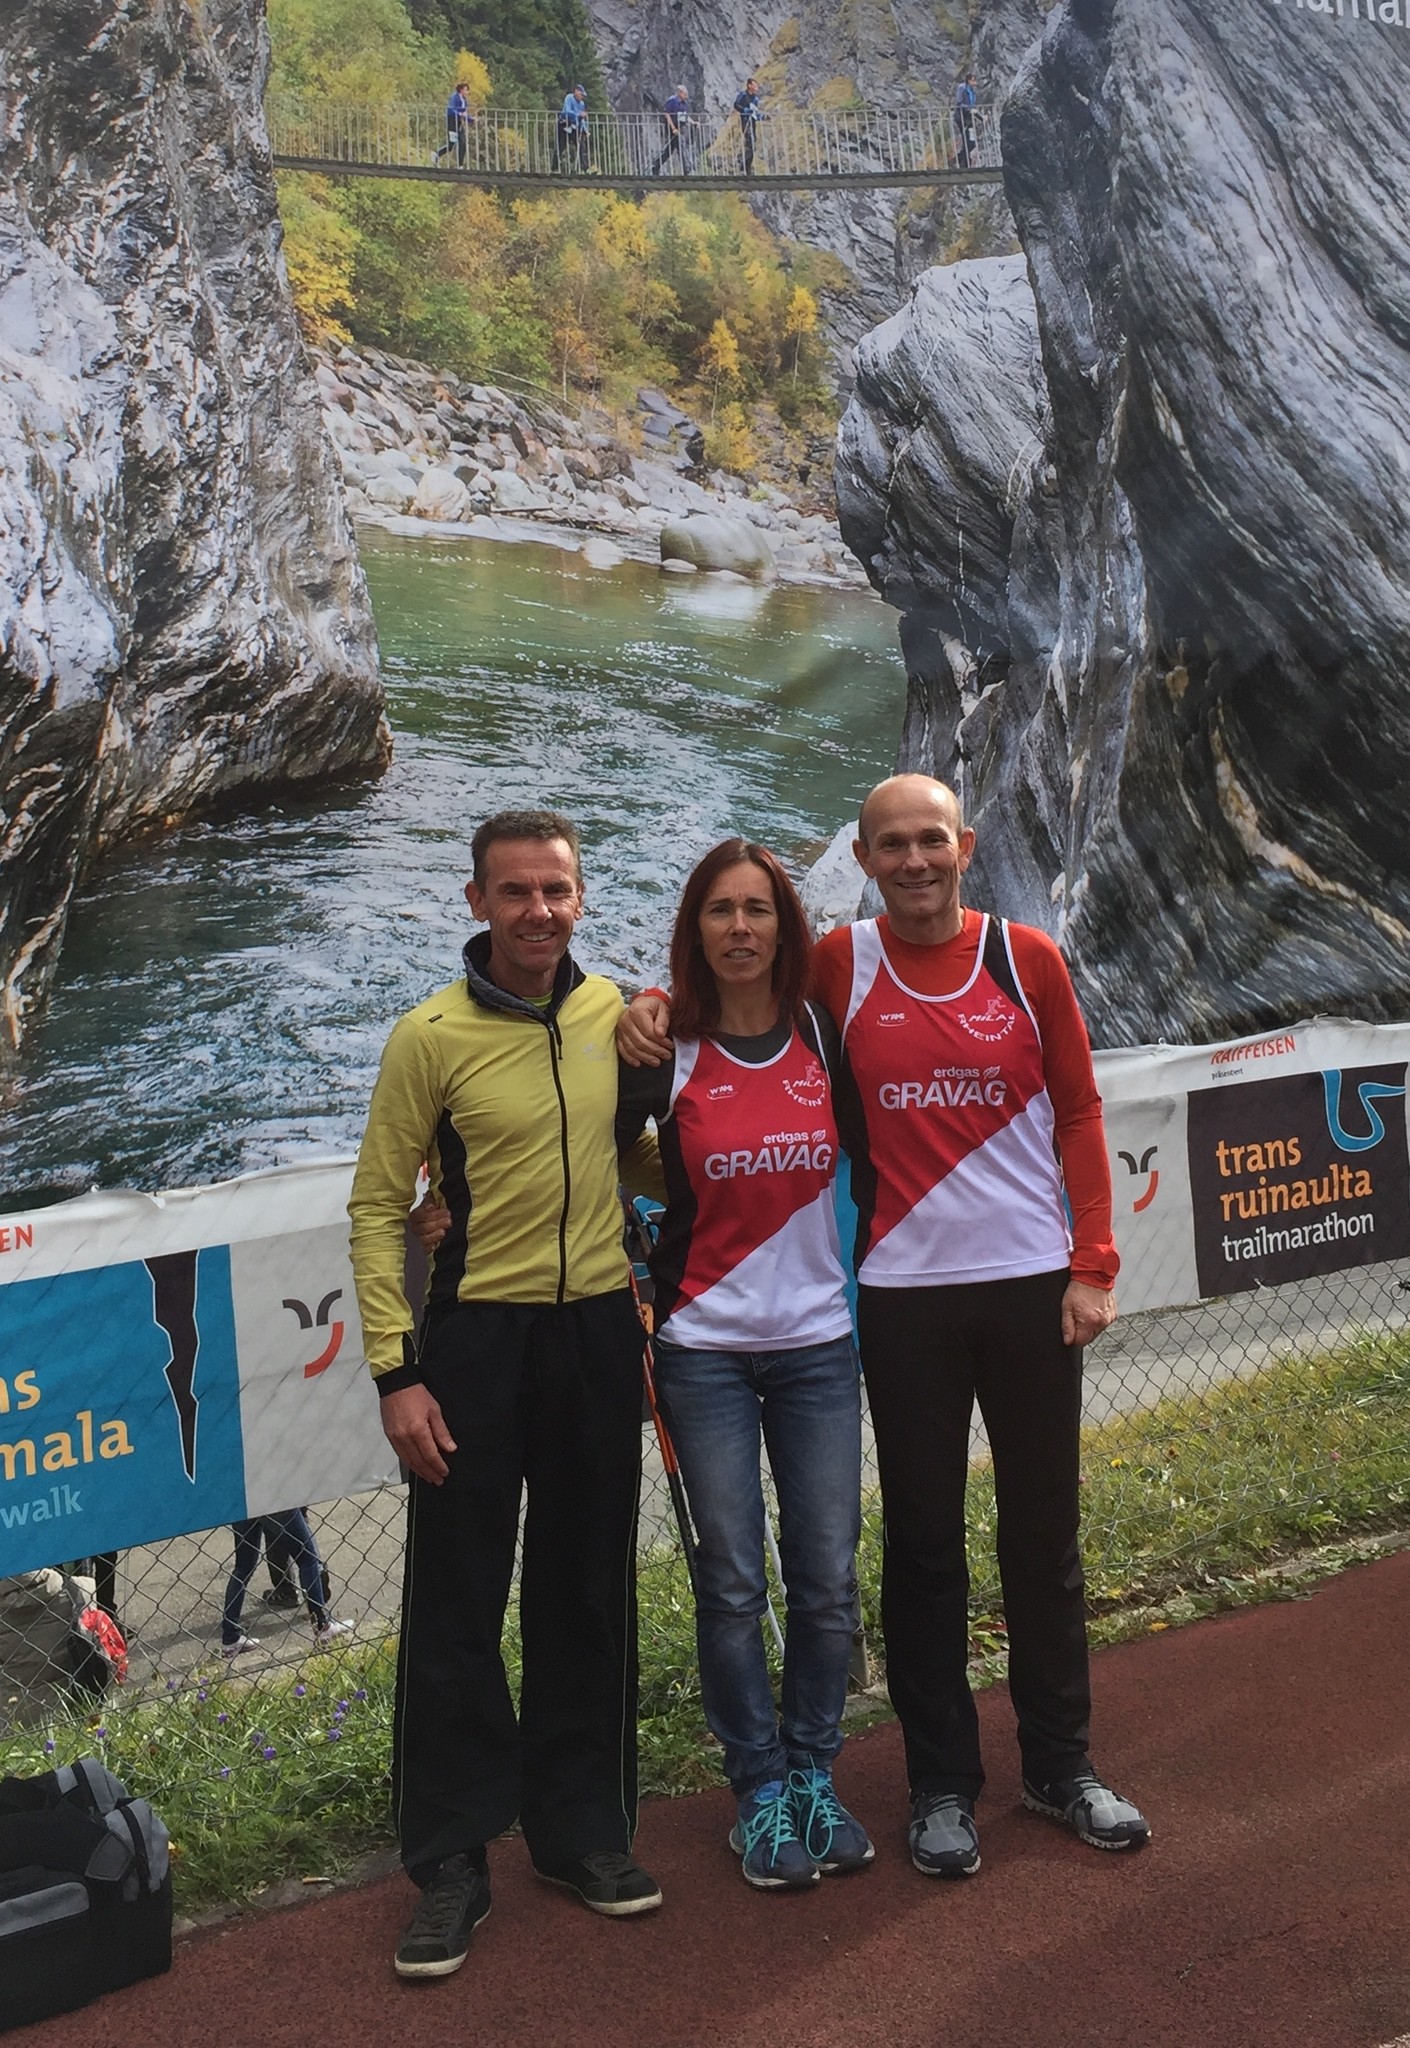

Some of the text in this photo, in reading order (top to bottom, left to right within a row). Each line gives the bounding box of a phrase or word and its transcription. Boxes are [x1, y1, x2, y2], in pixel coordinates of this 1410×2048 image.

[957, 1011, 1015, 1042] RHEINTAL
[968, 1013, 1007, 1022] MILA
[1210, 1035, 1296, 1065] RAIFFEISEN
[933, 1066, 979, 1079] erdgas
[879, 1080, 1007, 1110] GRAVAG
[763, 1130, 809, 1144] erdgas
[704, 1143, 832, 1181] GRAVAG
[1215, 1136, 1301, 1177] trans
[1220, 1163, 1373, 1222] ruinaulta
[1222, 1212, 1375, 1262] trailmarathon
[0, 1484, 83, 1529] walk
